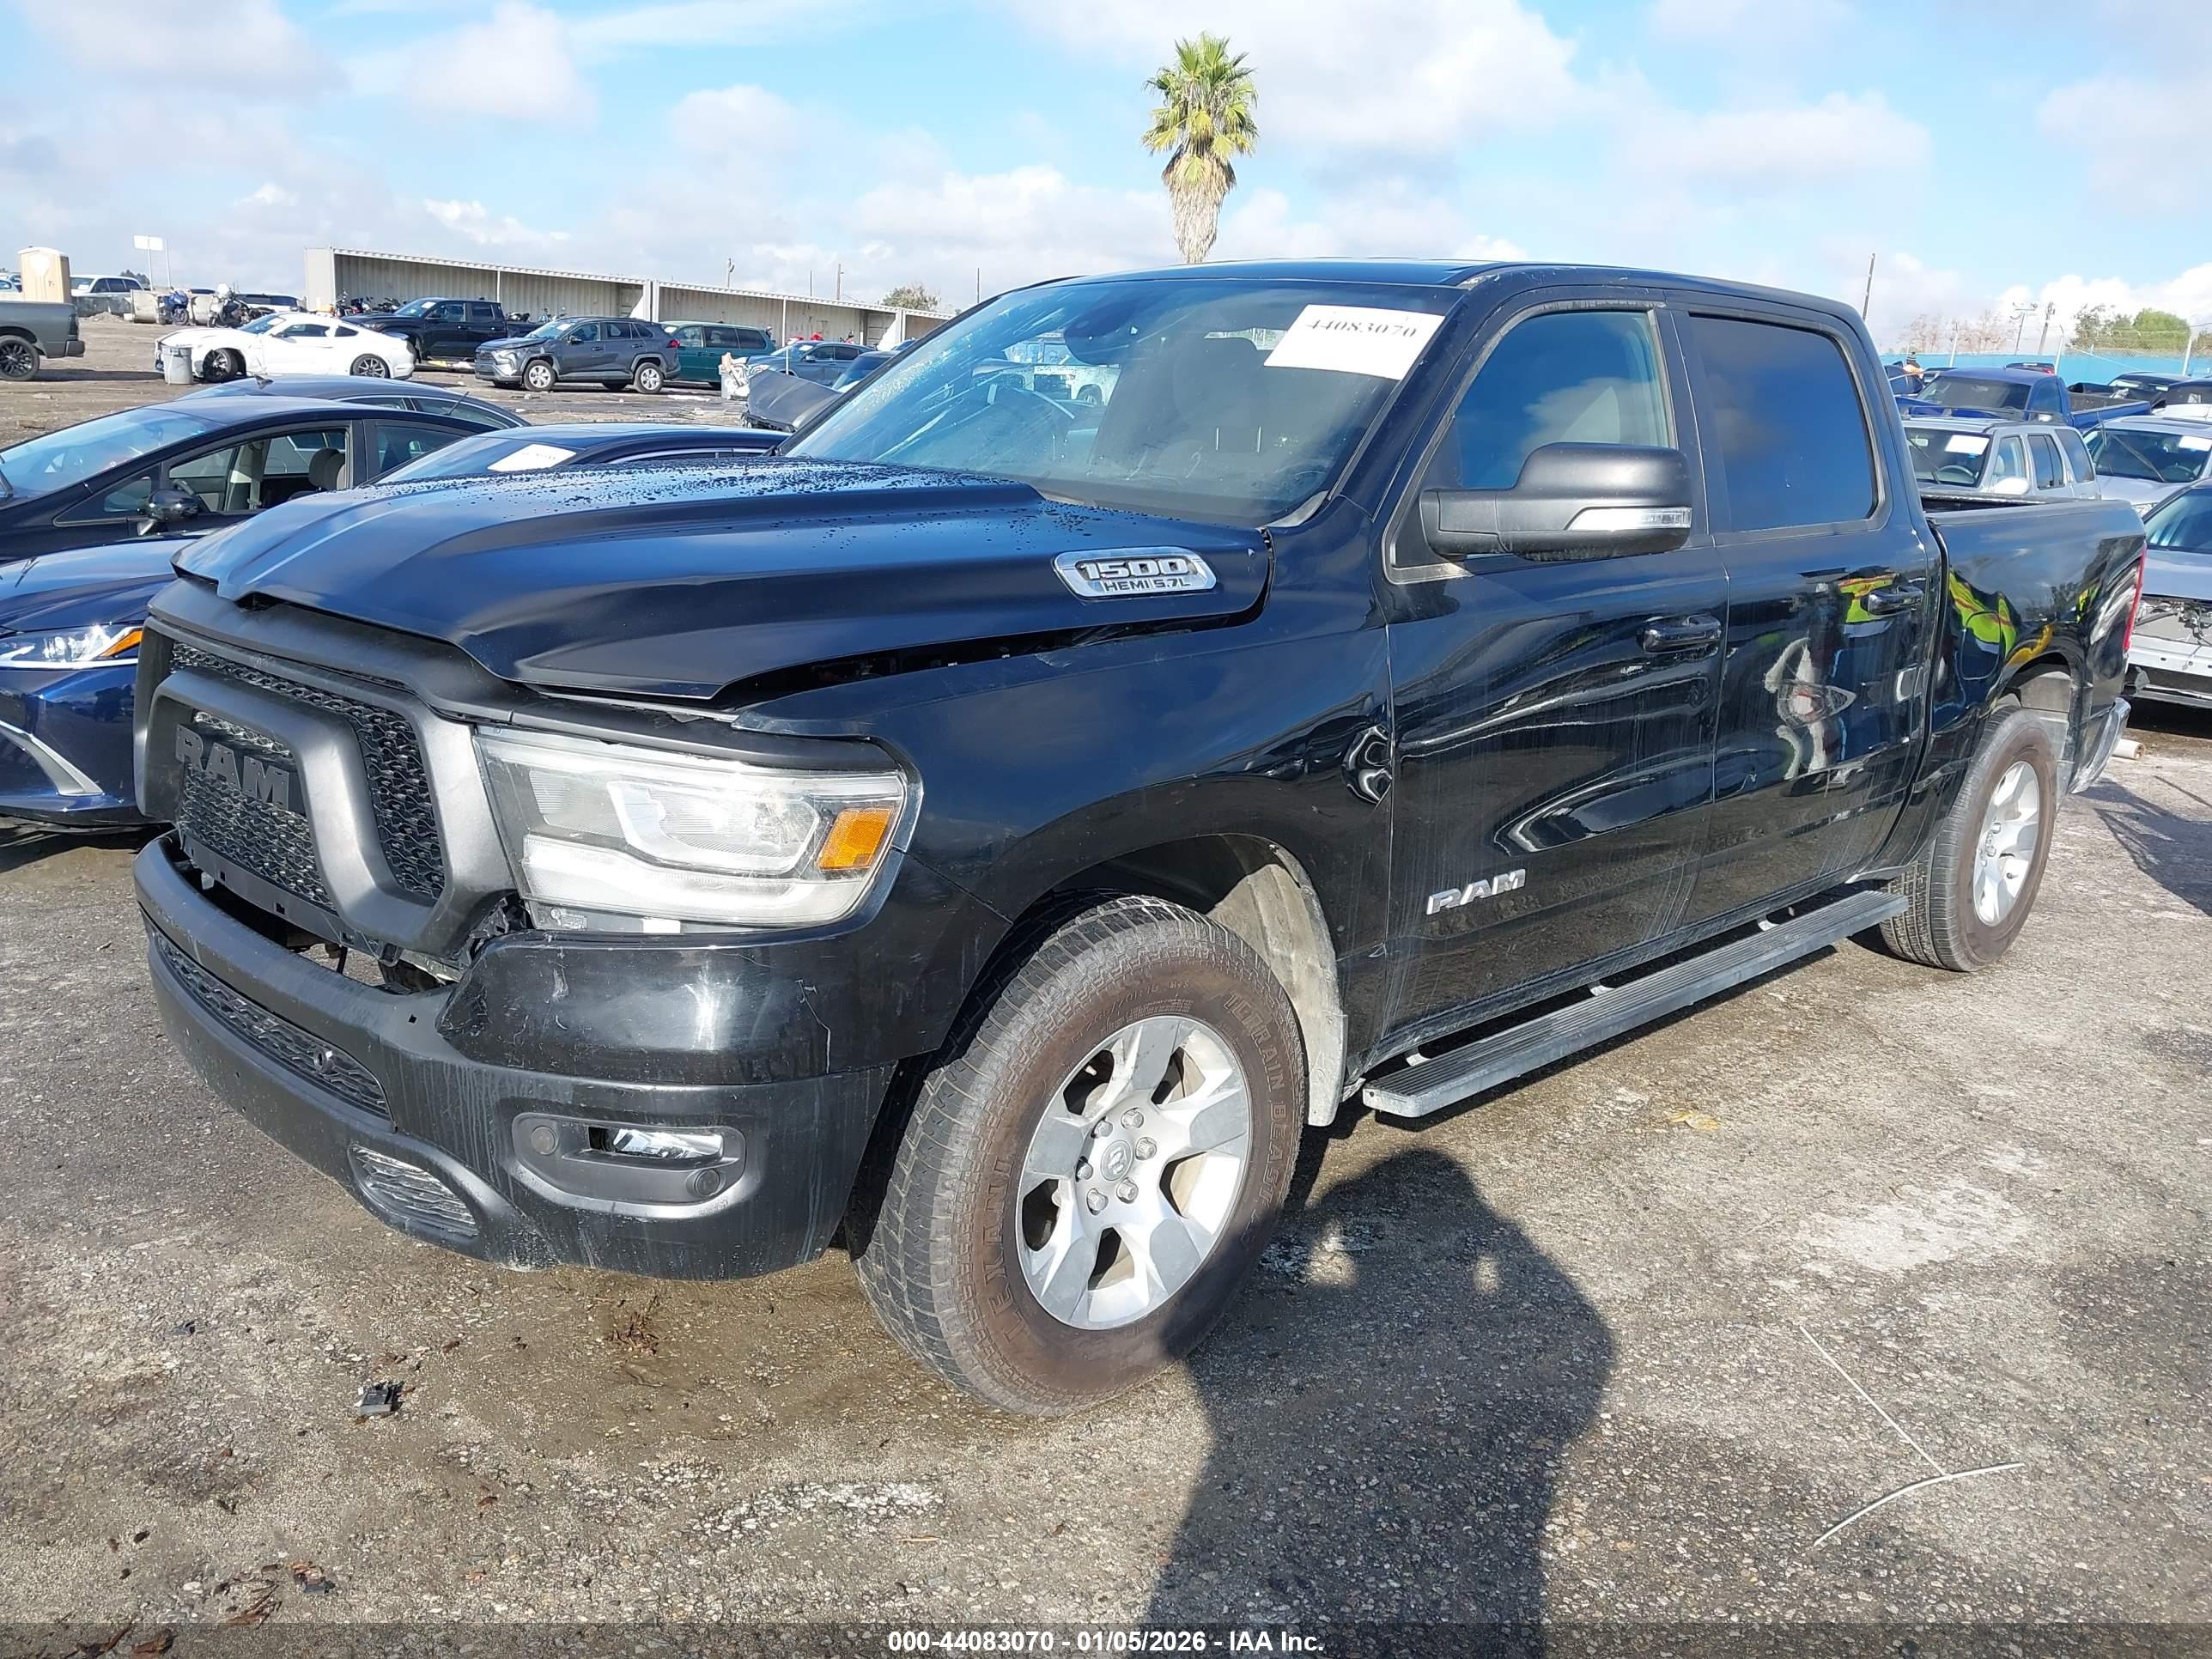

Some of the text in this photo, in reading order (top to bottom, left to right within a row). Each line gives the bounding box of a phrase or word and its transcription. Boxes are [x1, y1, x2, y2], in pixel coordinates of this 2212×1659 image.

[1305, 319, 1418, 337] 44083070
[1079, 558, 1189, 580] 1500
[1103, 577, 1191, 592] HEMI 5.7L
[175, 724, 289, 811] RAM
[1426, 868, 1526, 915] RAM
[1223, 990, 1285, 1091] TERRAIN
[1259, 1100, 1287, 1208] BEAST
[982, 1156, 1026, 1344] LEXANI
